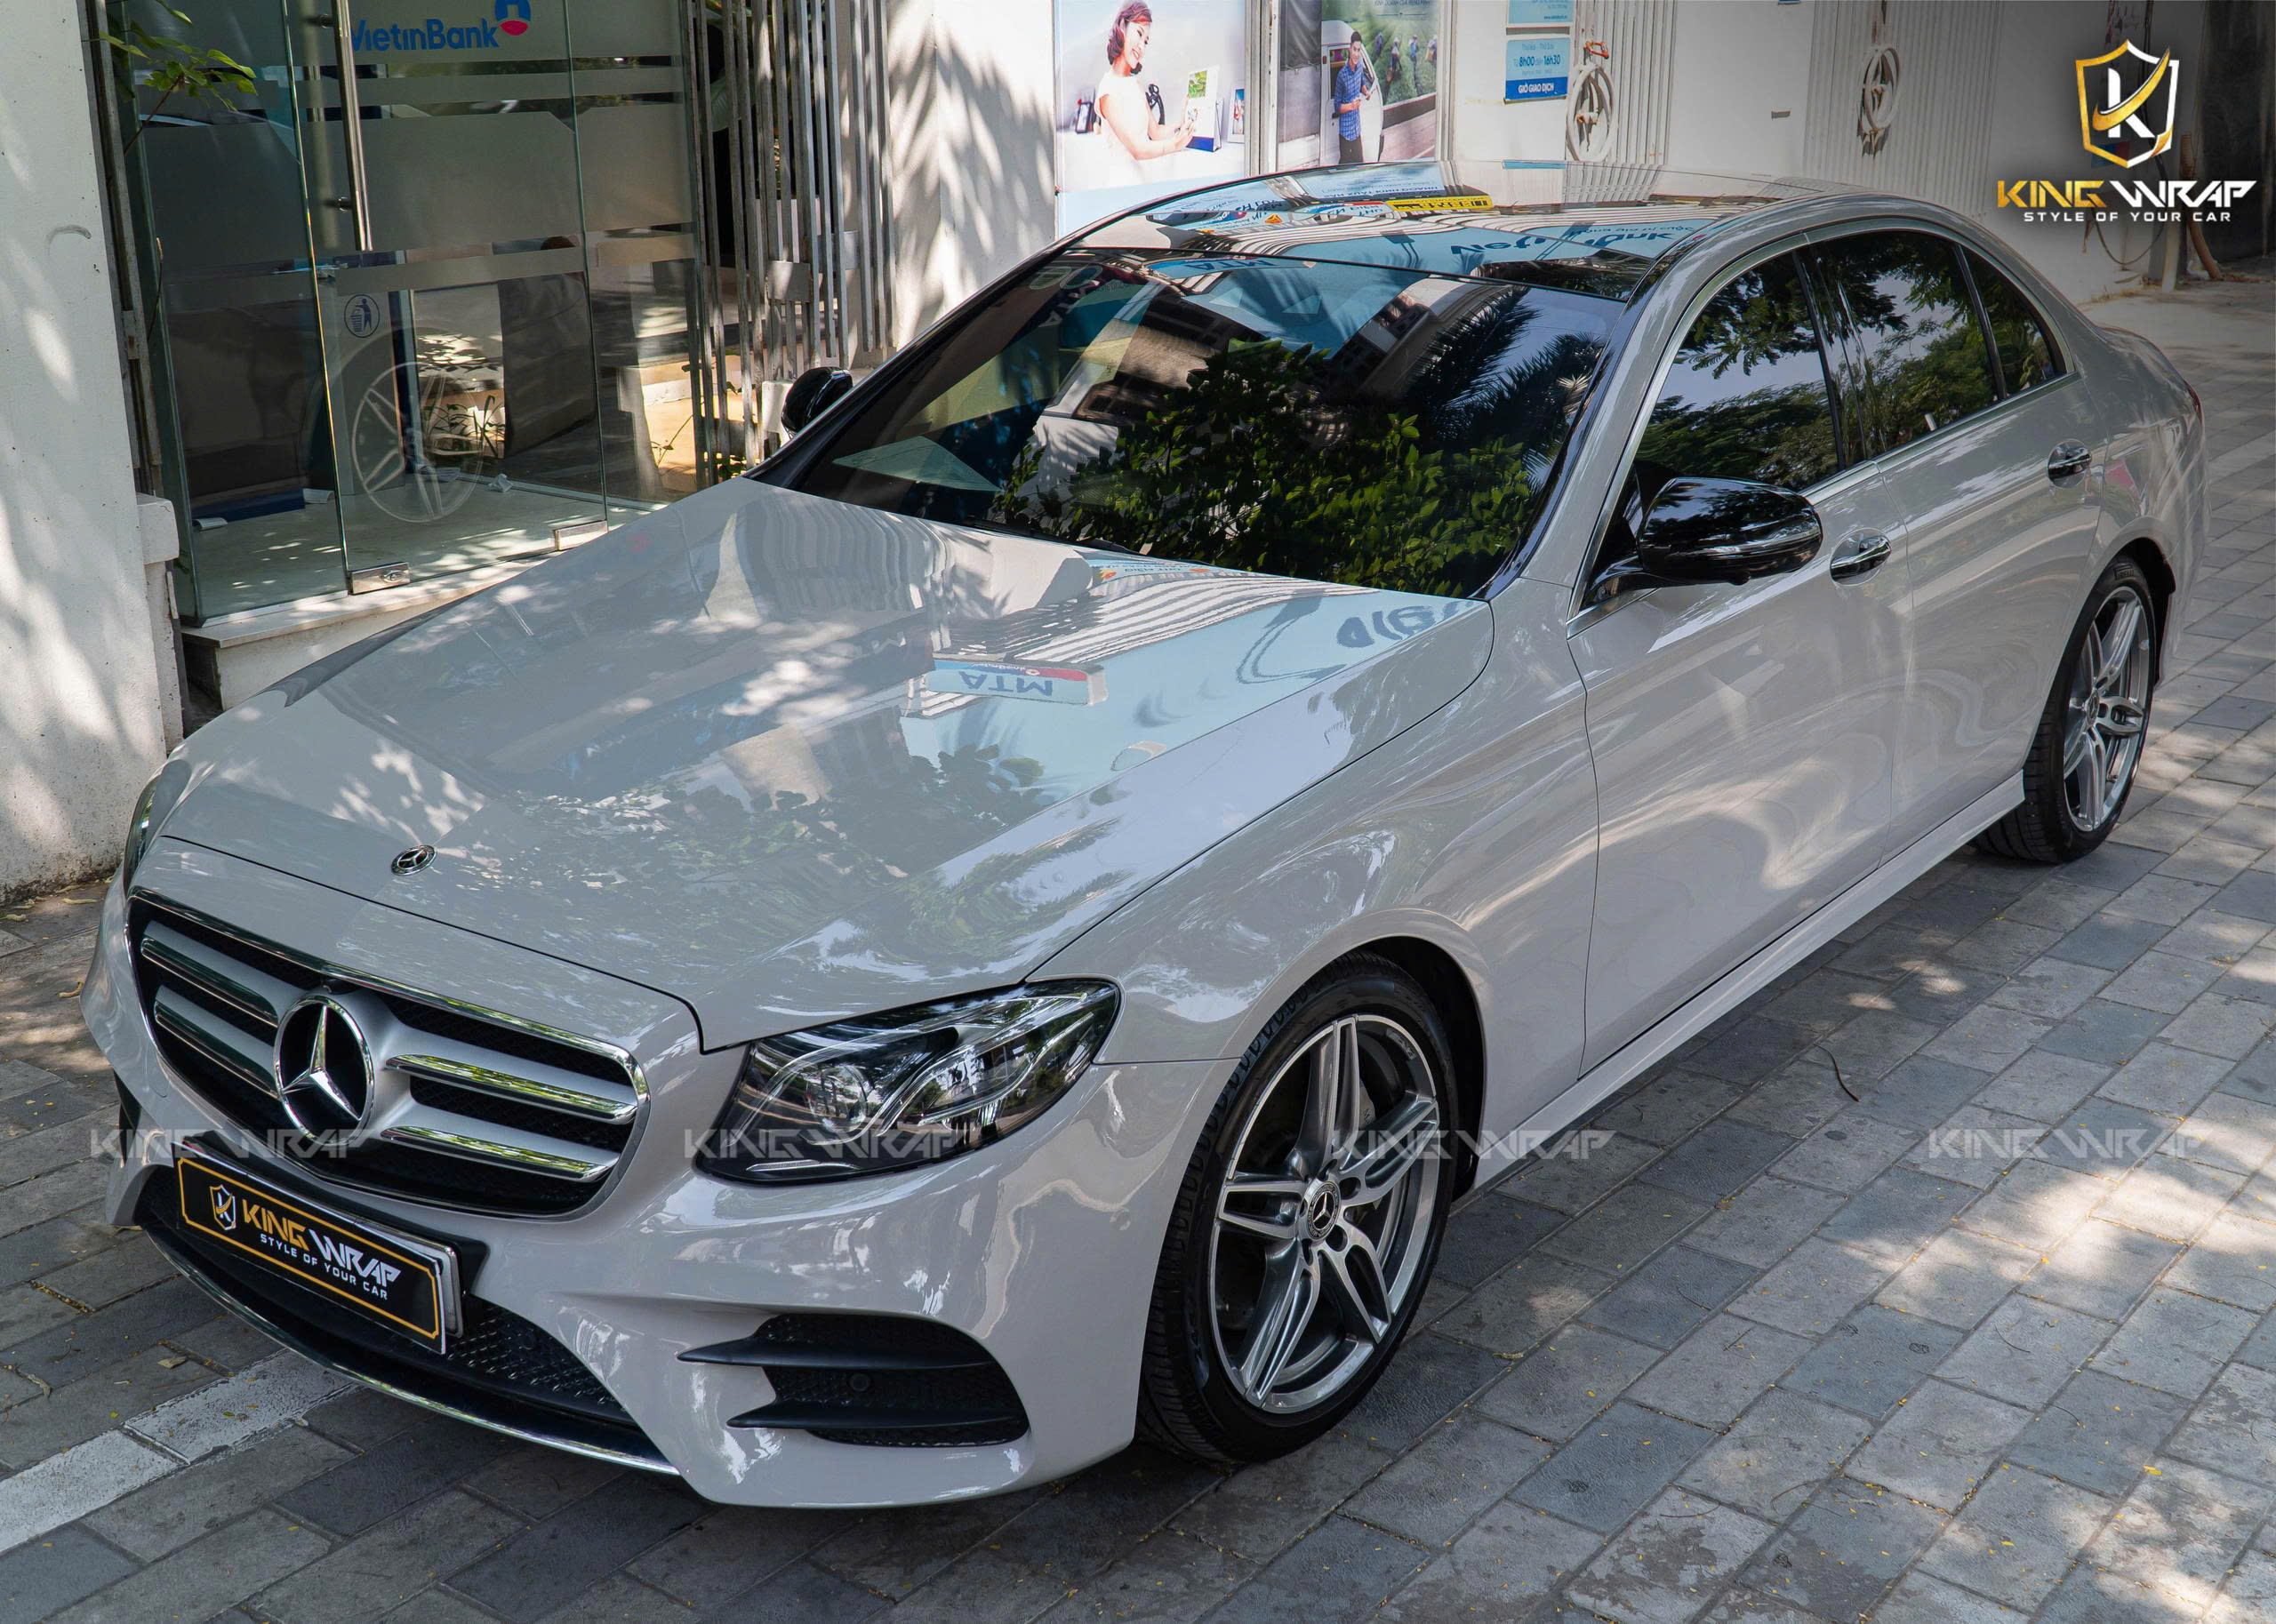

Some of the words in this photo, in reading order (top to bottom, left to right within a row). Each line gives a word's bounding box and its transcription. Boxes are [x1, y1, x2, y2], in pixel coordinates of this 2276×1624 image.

[1519, 56, 1535, 68] 8h00
[1543, 54, 1561, 66] 16h30
[243, 1199, 309, 1252] KING
[309, 1228, 401, 1287] WRAP
[260, 1234, 298, 1258] STYLE
[303, 1255, 318, 1267] OF
[325, 1263, 357, 1286] YOUR
[363, 1280, 388, 1300] CAR
